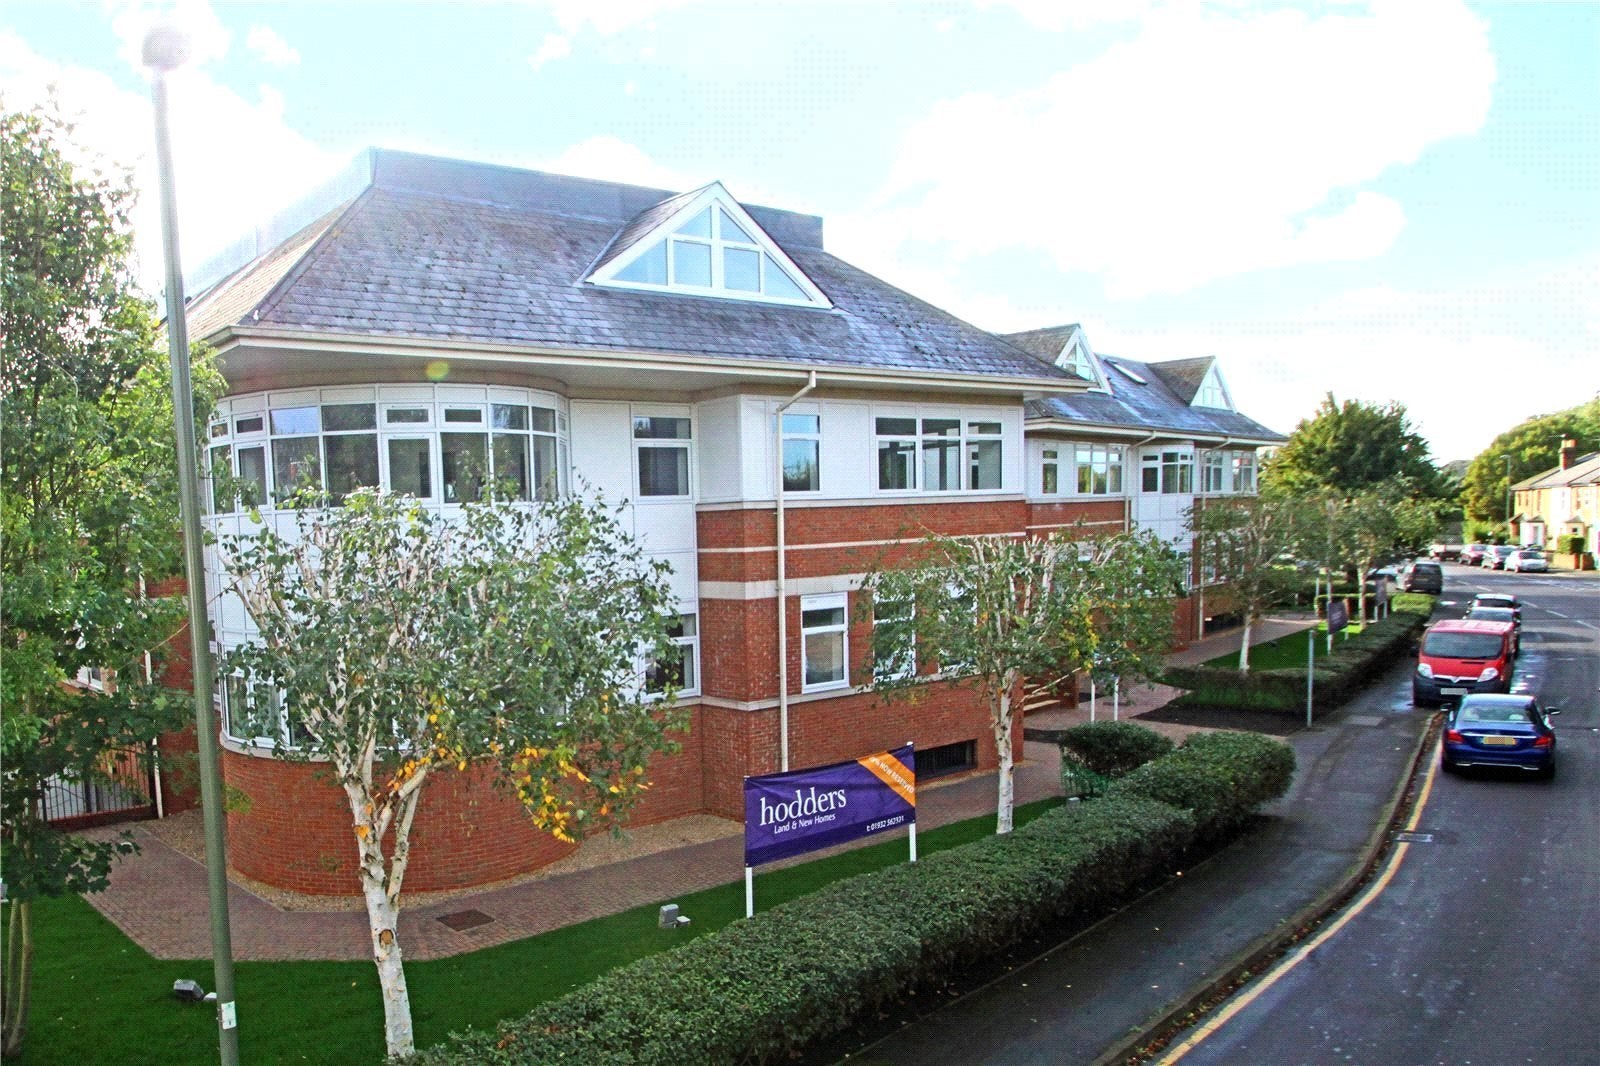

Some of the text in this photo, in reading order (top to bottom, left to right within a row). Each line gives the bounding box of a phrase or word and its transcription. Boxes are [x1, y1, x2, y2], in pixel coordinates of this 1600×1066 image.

[759, 786, 847, 826] hodders
[774, 813, 836, 834] Land & New Homes
